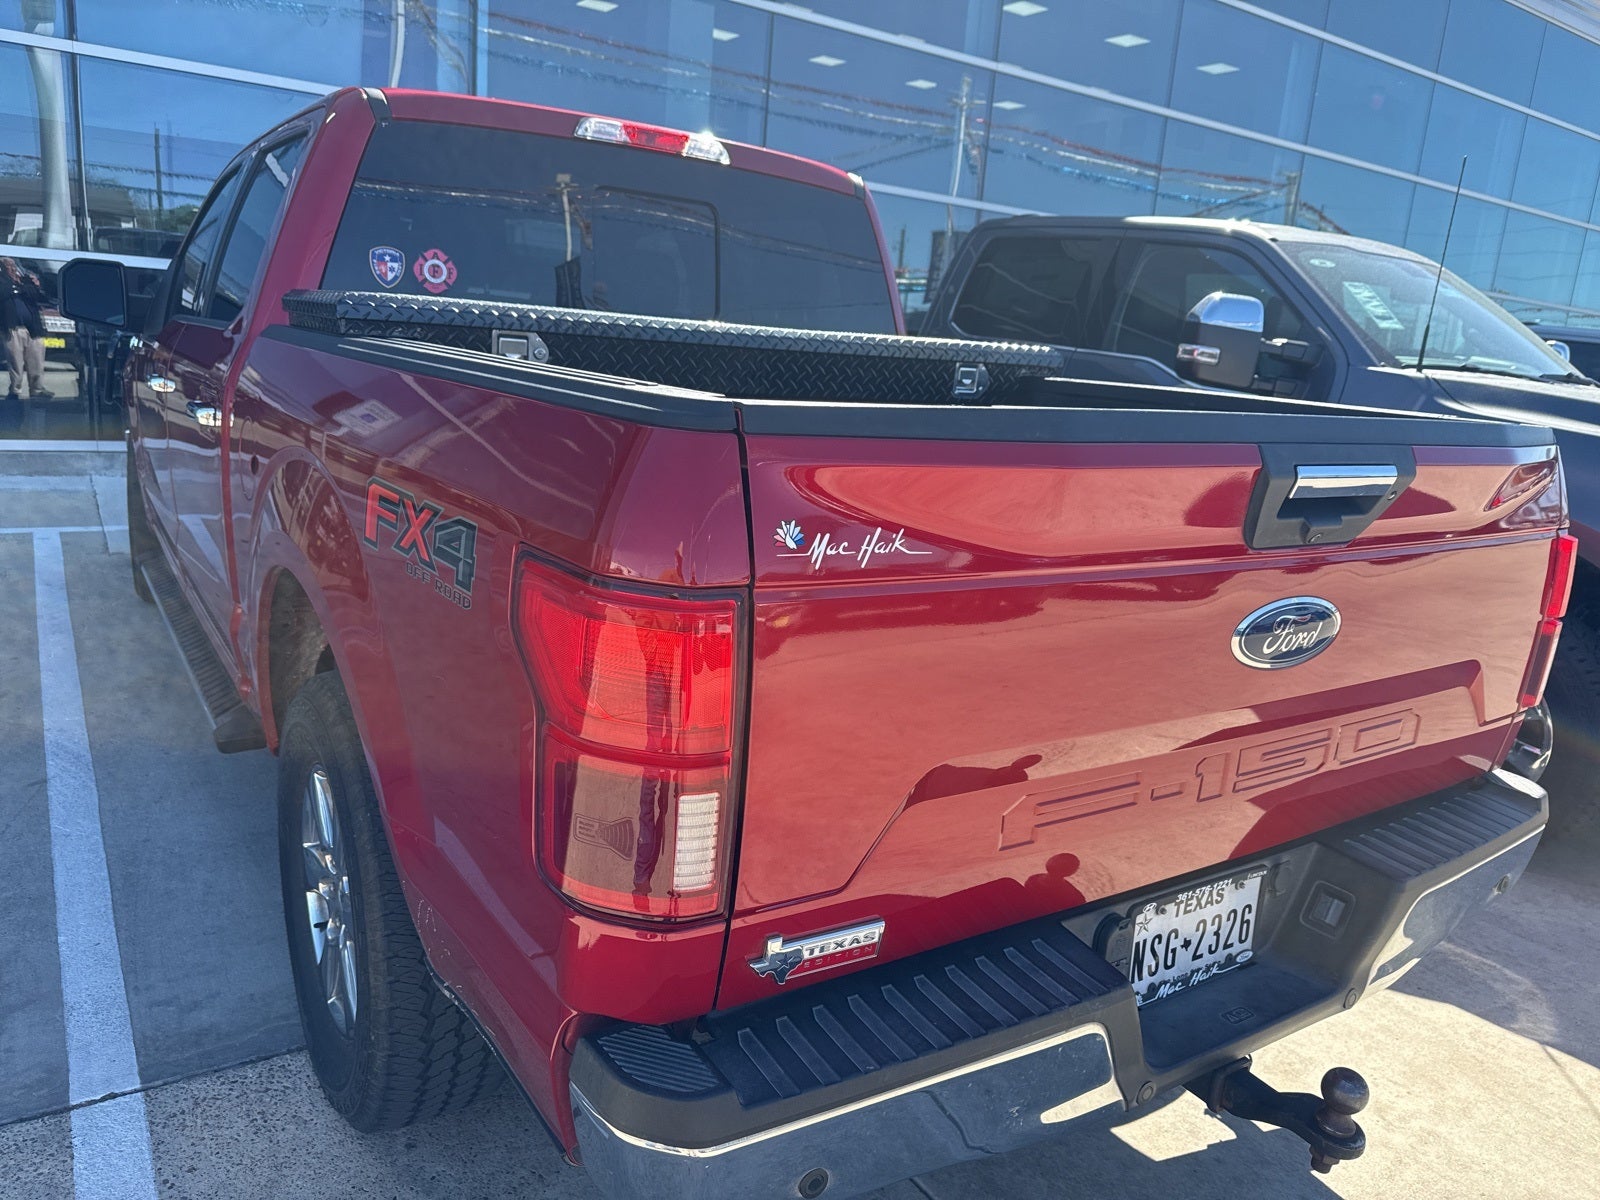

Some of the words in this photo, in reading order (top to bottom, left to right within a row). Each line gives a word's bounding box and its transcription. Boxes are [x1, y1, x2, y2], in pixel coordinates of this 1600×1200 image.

[363, 476, 478, 594] FX4
[797, 533, 856, 570] Mac
[857, 527, 924, 568] Haik
[406, 562, 432, 585] OFF
[434, 578, 472, 610] ROAD
[1262, 613, 1324, 654] Ford
[998, 708, 1422, 851] F-150
[1174, 888, 1225, 918] TEXAS
[1176, 878, 1233, 902] 361-576-1221
[803, 944, 873, 969] EDITION
[804, 931, 877, 957] TEXAS
[1152, 981, 1186, 999] Mac
[1188, 963, 1230, 987] Haik
